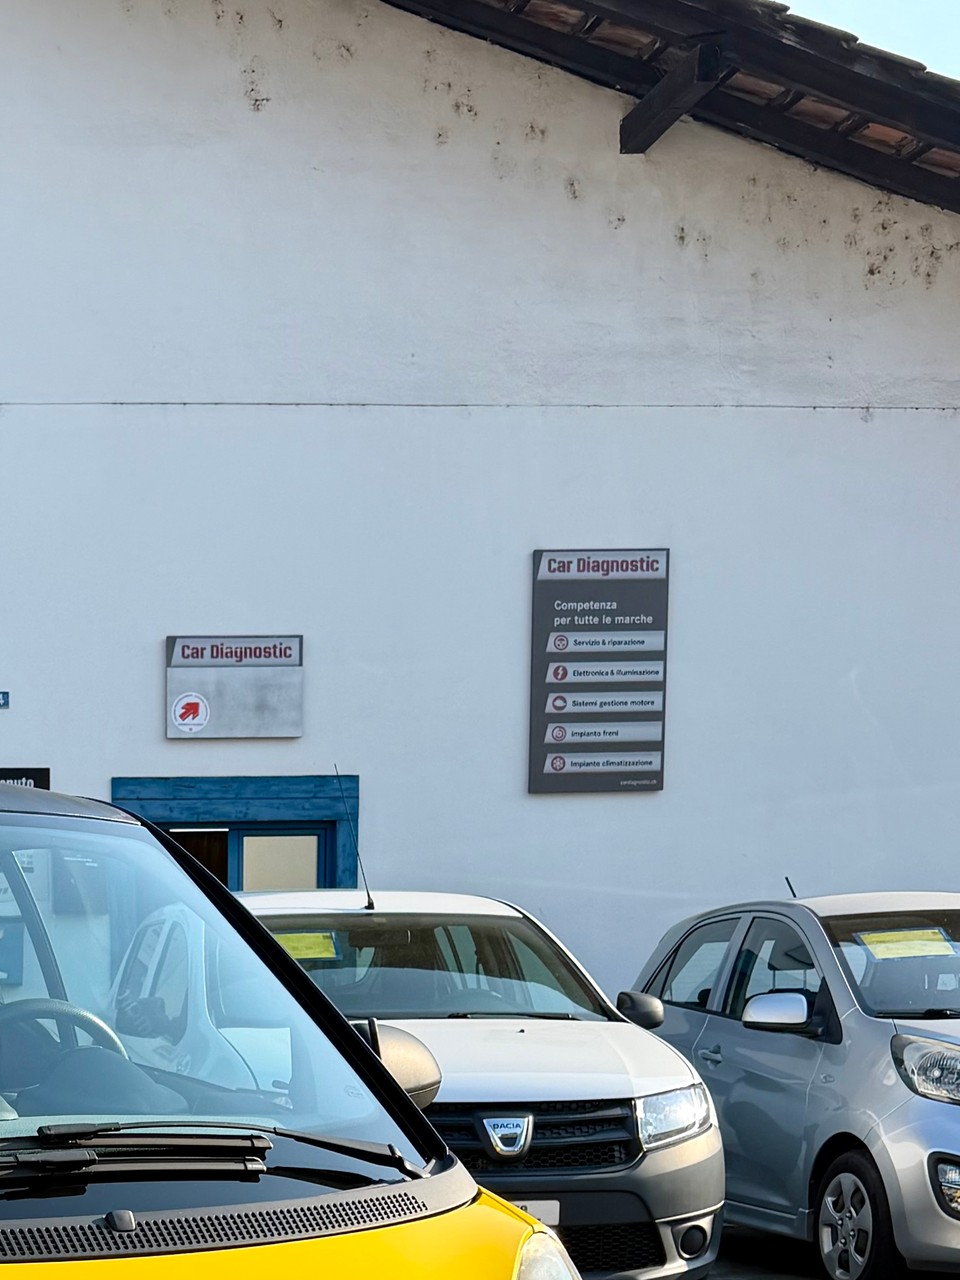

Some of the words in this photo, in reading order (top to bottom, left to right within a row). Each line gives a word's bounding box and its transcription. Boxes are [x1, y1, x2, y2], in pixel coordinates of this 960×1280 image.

[547, 558, 573, 573] Car
[577, 556, 660, 576] Diagnostic
[554, 600, 617, 612] Competenza
[554, 616, 571, 627] per
[574, 614, 599, 625] tutte
[602, 614, 612, 625] le
[615, 614, 653, 624] marche
[573, 638, 600, 647] Servizio
[608, 637, 645, 648] riparazione
[181, 644, 207, 659] Car
[210, 642, 293, 663] Diagnostic
[573, 669, 609, 678] Elettronica
[572, 700, 597, 708] Sistemi
[599, 700, 628, 709] gestione
[630, 699, 655, 707] motore
[571, 730, 601, 738] Impianto
[603, 729, 619, 737] freni
[570, 760, 600, 769] Impianto
[602, 759, 653, 768] climatizzazione
